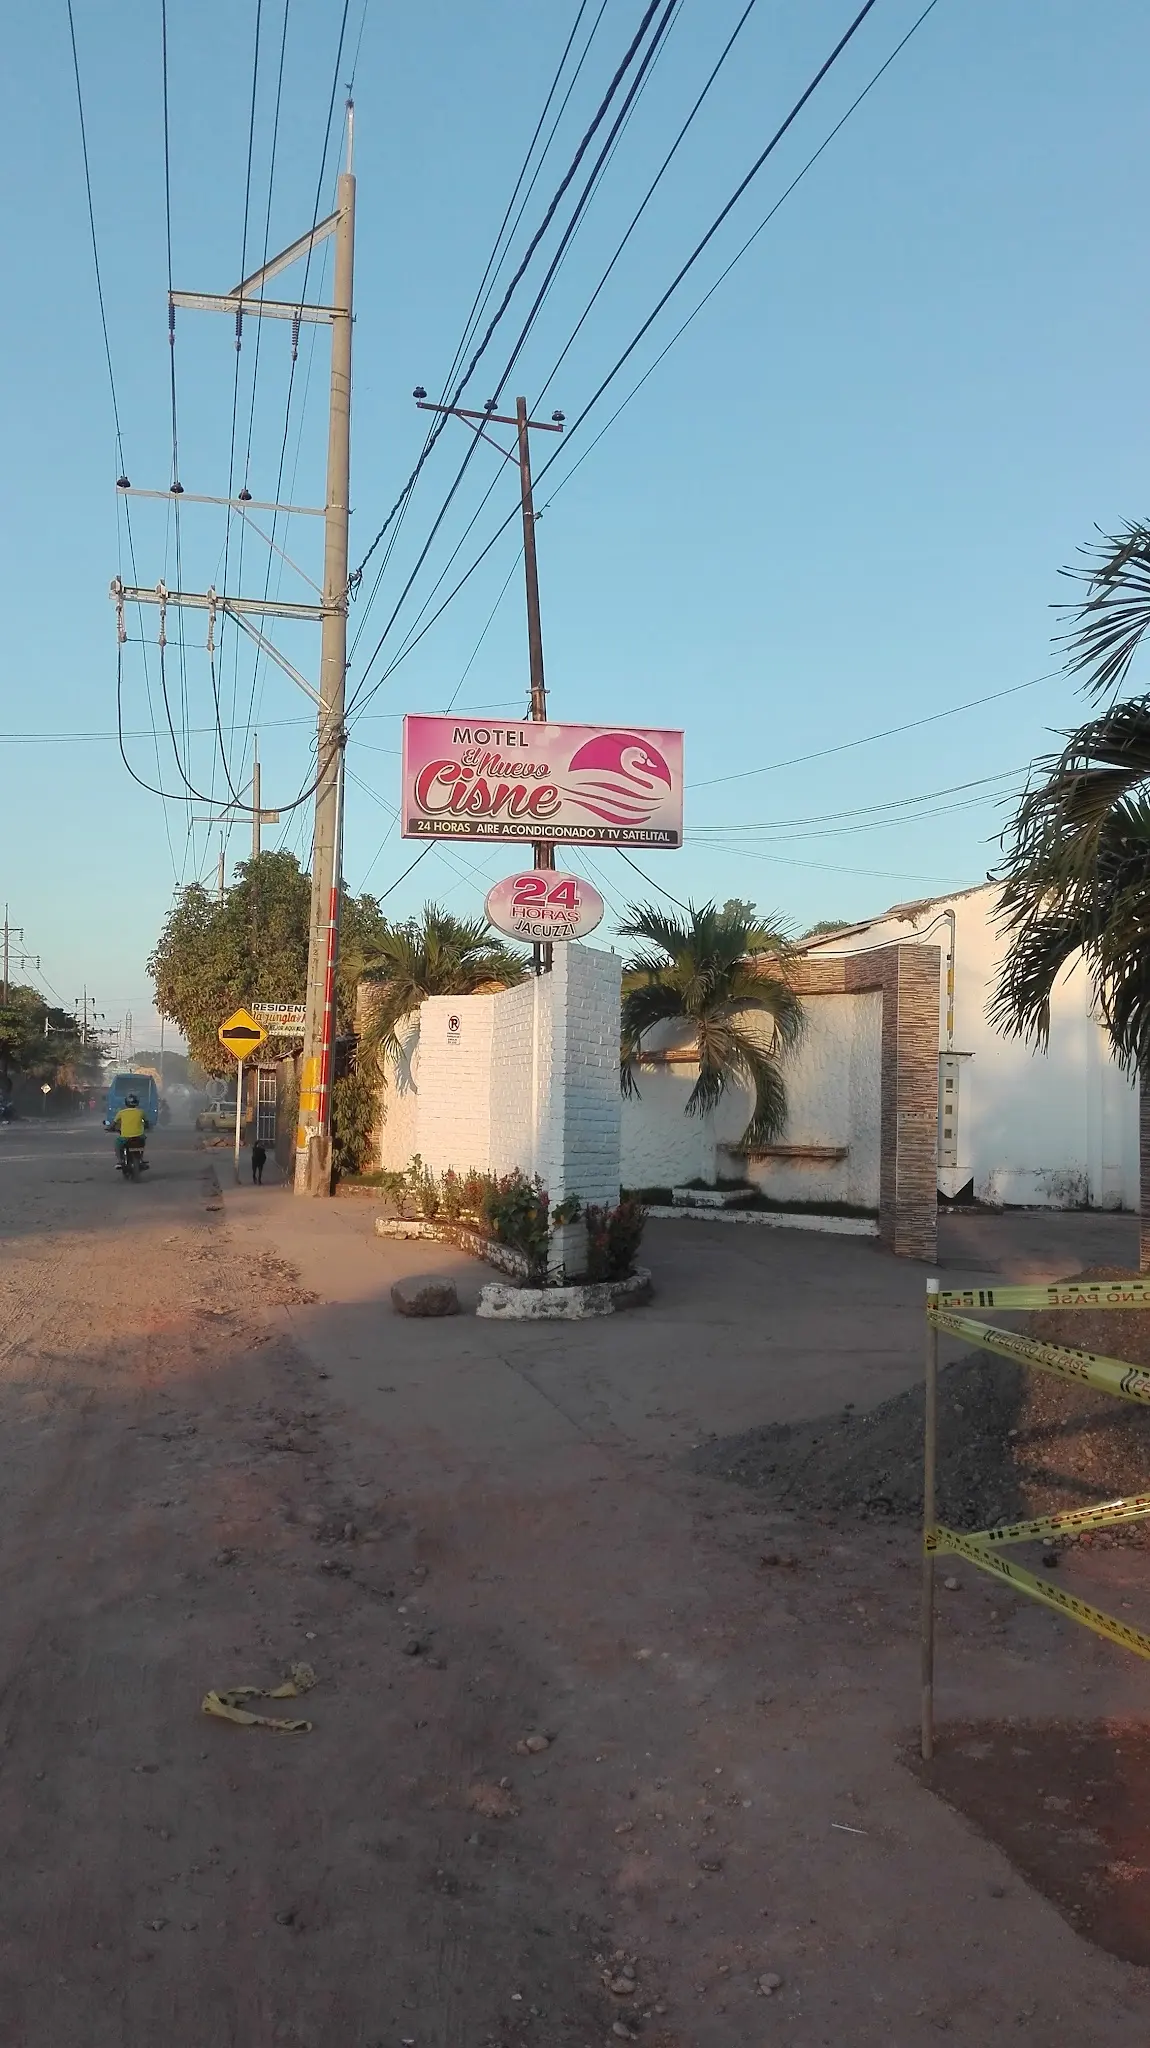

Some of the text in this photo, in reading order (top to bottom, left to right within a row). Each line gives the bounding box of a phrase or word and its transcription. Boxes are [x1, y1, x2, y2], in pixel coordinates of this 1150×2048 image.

[453, 727, 529, 747] MOTEL
[462, 747, 551, 778] El Nuevo
[416, 759, 563, 820] Cisne
[417, 821, 670, 842] 24 HORAS AIRE ACONDICIONADO Y TV SATELITAL
[511, 876, 580, 922] 24 HORAS
[514, 920, 576, 937] JACUZZI
[992, 1333, 1092, 1372] PELIGRO NO PASE
